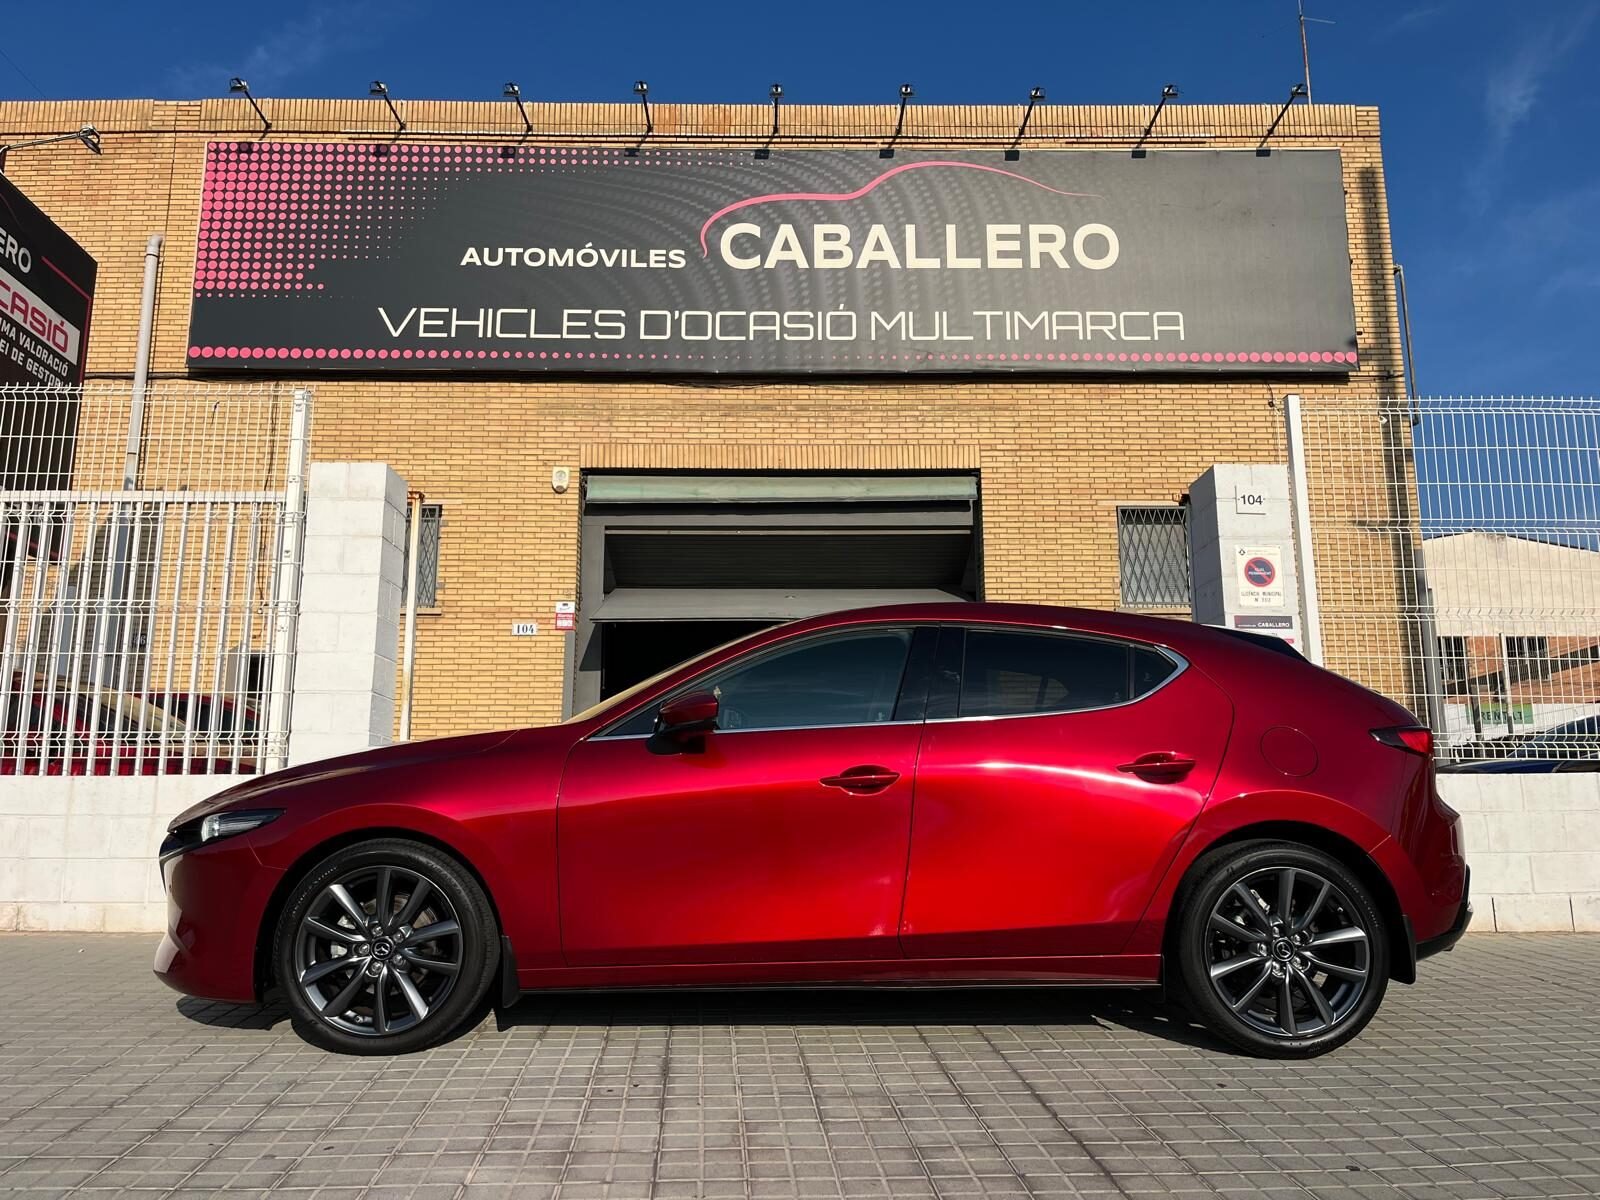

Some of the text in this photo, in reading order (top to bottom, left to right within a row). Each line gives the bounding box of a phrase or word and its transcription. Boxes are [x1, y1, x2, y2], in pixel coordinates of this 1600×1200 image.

[460, 222, 1120, 270] AUTOMÓVILES CABALLERO
[377, 304, 1185, 342] VEHICLES D'OCASIÓ MULTIMARCA
[11, 347, 25, 366] DE
[19, 331, 69, 377] VALORACIÓ
[1240, 494, 1264, 506] 104
[516, 624, 534, 634] 104
